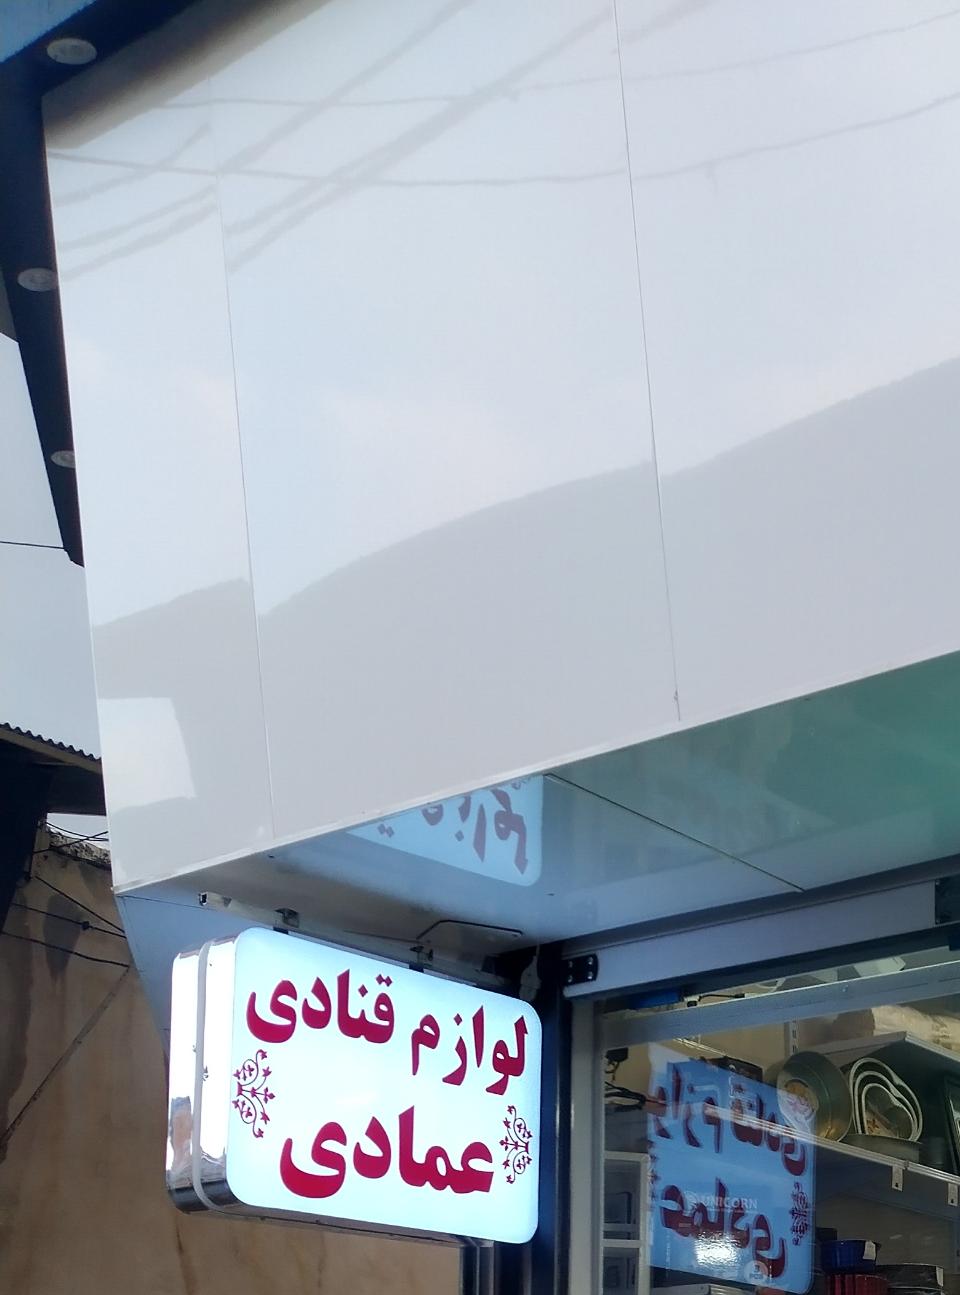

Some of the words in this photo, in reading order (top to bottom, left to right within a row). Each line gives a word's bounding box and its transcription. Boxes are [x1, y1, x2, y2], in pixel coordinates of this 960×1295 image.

[246, 969, 395, 1043] قنادی
[411, 1005, 528, 1095] لوازم
[280, 1105, 495, 1198] عمادی
